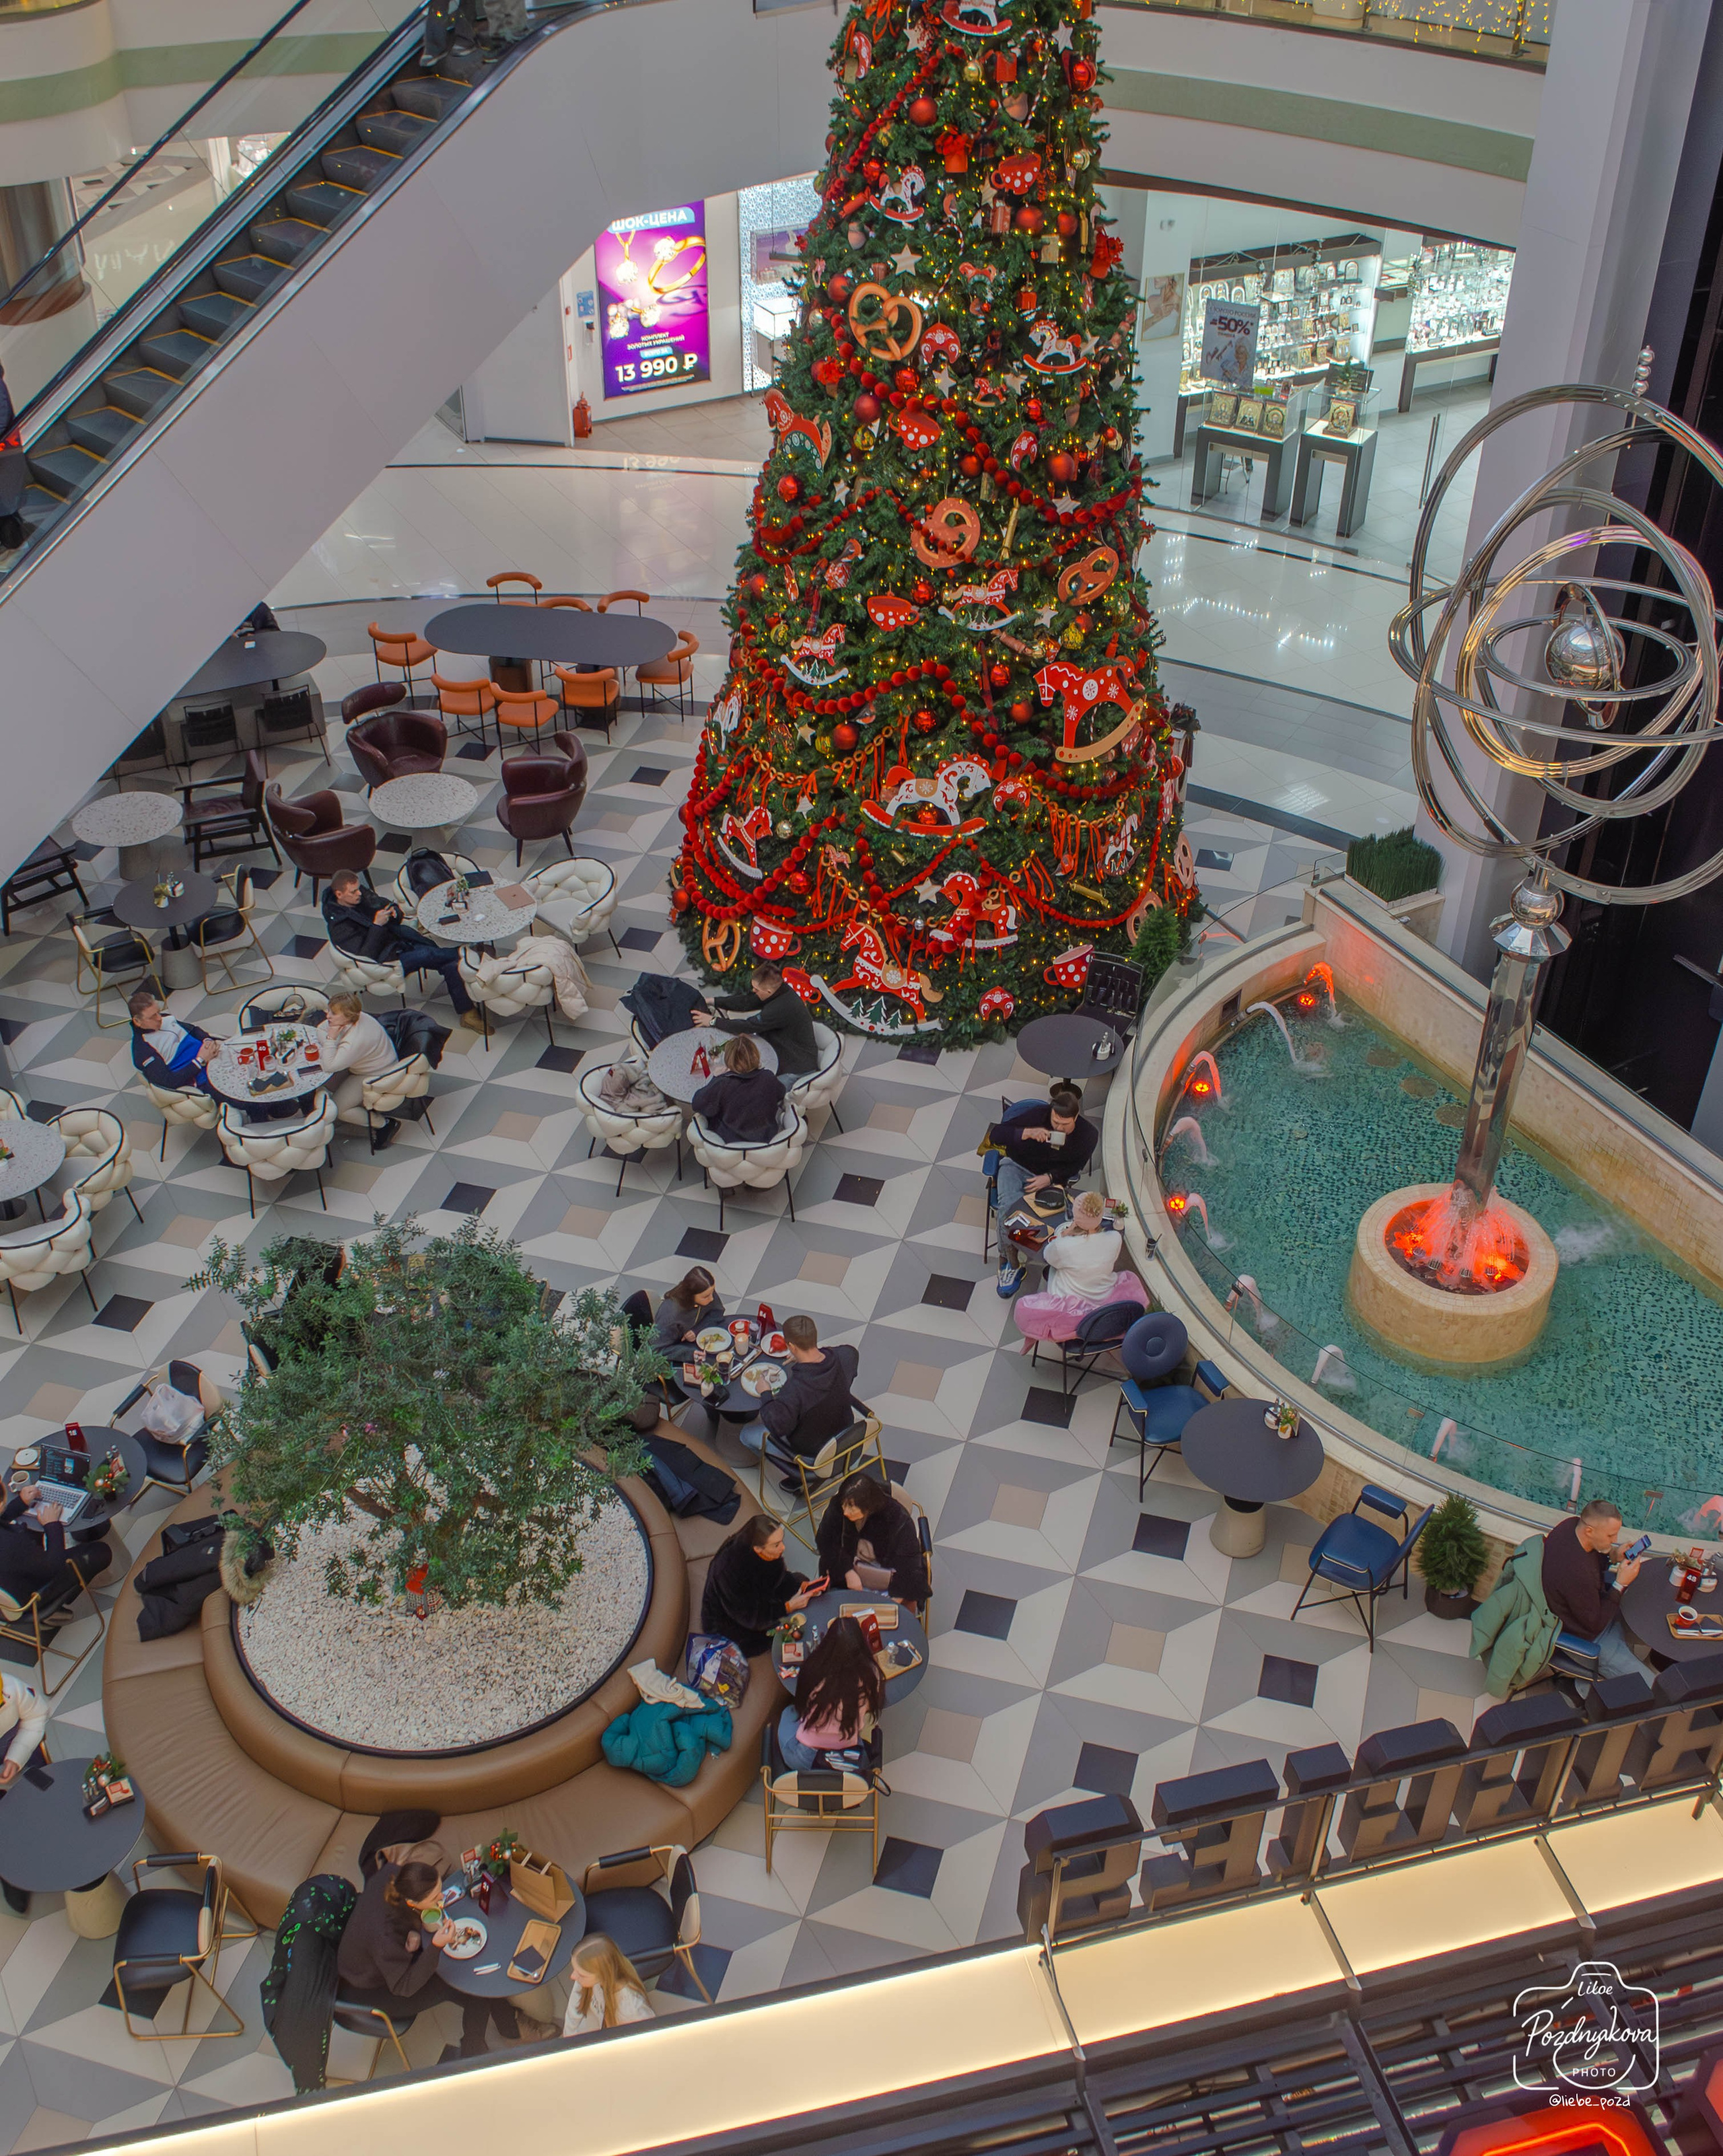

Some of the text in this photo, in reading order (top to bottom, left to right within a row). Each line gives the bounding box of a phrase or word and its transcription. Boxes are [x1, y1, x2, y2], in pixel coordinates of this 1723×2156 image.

[611, 209, 687, 231] ШОК-ЦЕНА
[614, 363, 636, 383] 13
[640, 355, 678, 378] 990
